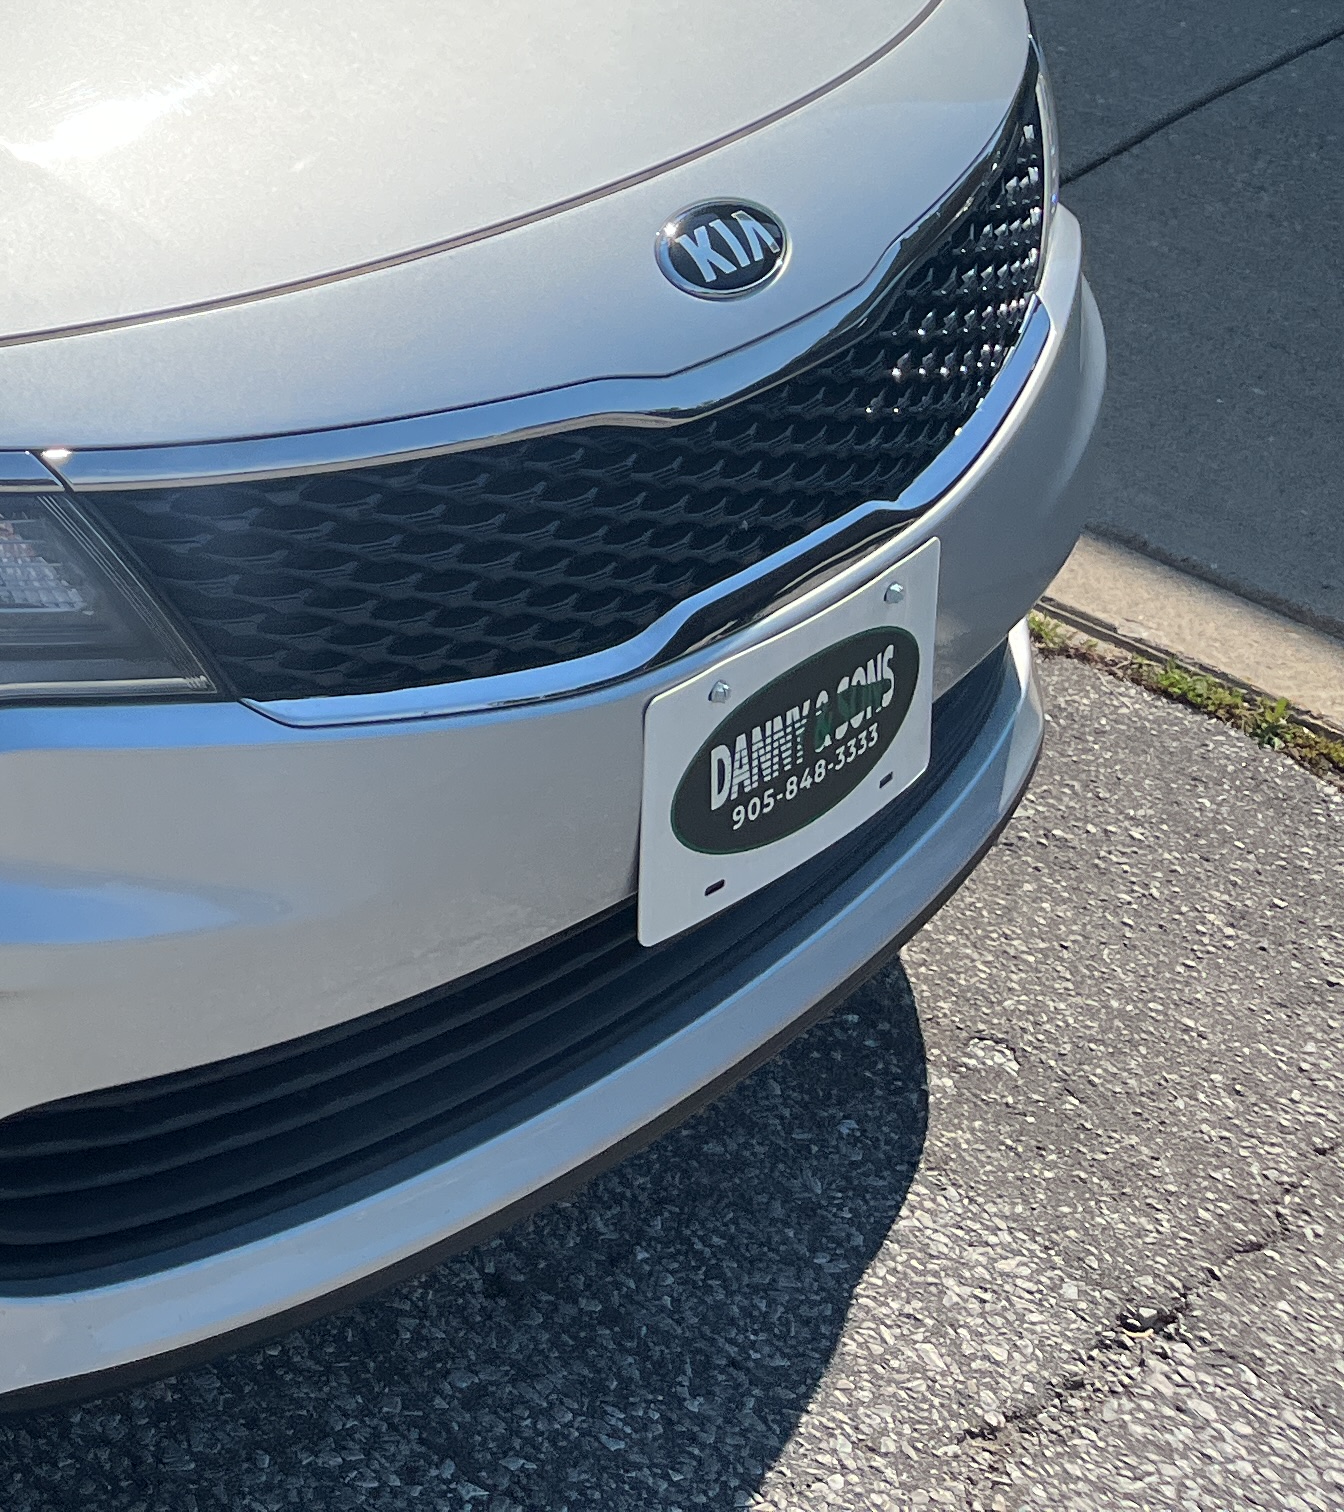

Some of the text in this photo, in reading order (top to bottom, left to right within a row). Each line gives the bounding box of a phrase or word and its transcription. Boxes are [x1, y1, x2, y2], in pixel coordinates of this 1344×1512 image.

[674, 209, 781, 283] KIA
[710, 697, 811, 811] DANNY
[835, 644, 895, 740] SONS
[731, 722, 879, 831] 905-848-3333
